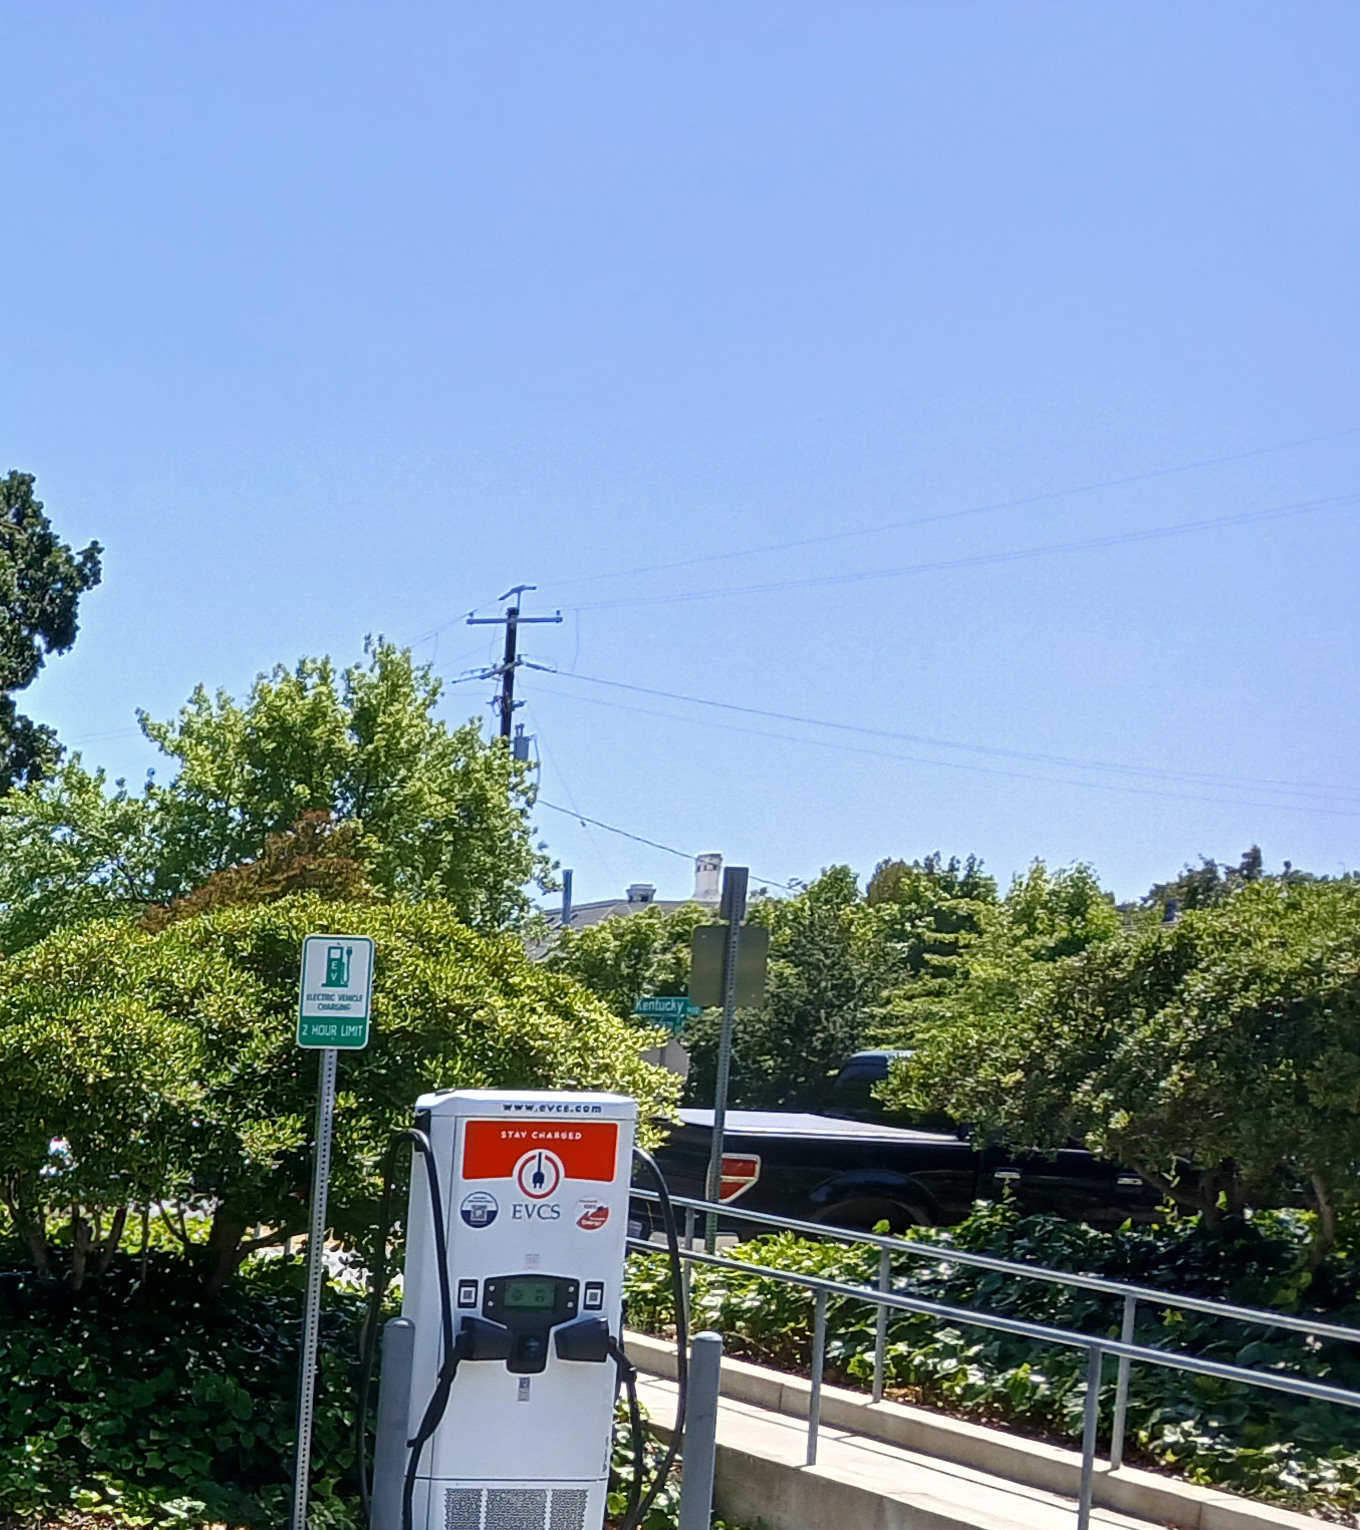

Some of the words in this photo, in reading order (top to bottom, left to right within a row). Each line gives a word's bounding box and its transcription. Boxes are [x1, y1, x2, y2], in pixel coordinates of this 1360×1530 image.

[331, 961, 338, 981] EV
[306, 993, 335, 1002] ELECTRIC
[338, 994, 363, 1002] VEHICLE
[317, 1003, 351, 1011] CHARGING
[635, 998, 684, 1014] Kentucky
[302, 1024, 309, 1036] 2
[311, 1024, 337, 1037] HOUR
[341, 1025, 364, 1037] LIMIT
[503, 1104, 603, 1114] www.evcs.com
[500, 1130, 528, 1140] STAY
[531, 1131, 582, 1140] CHARGED
[511, 1203, 561, 1220] EVCS
